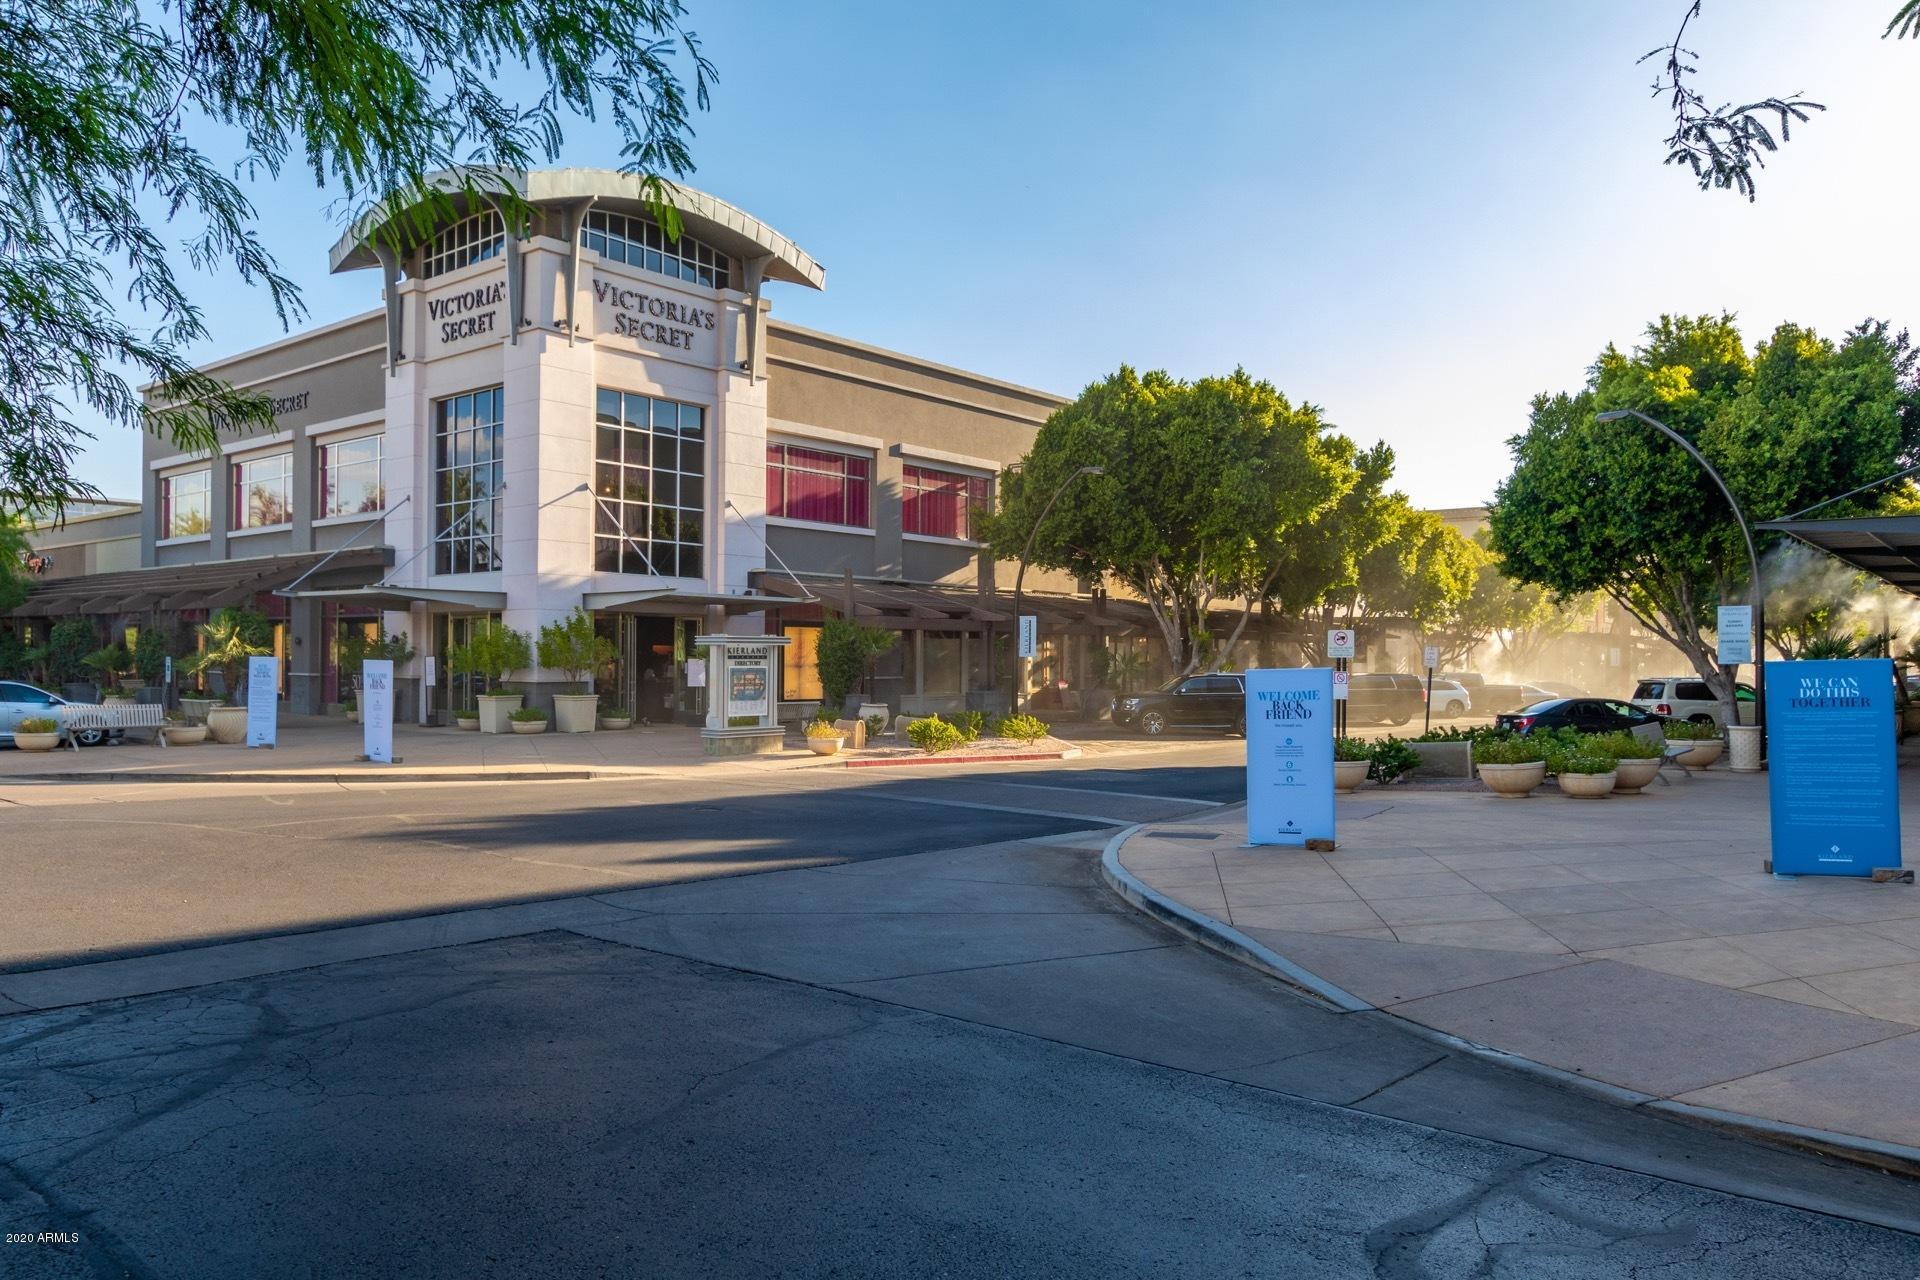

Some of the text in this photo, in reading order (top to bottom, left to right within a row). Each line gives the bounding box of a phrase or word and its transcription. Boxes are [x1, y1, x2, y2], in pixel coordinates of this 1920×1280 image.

[427, 280, 506, 321] VICTORIA'
[592, 278, 716, 331] VICTORIA'S
[441, 310, 496, 343] SECRET
[614, 312, 694, 350] SECRET
[727, 646, 768, 655] KIERLAND
[1800, 677, 1858, 688] WE CAN
[1257, 690, 1321, 702] WELCOME
[1800, 687, 1860, 698] DO THIS
[1272, 700, 1305, 711] BACK
[1791, 697, 1871, 709] TOGETHER
[1265, 709, 1312, 720] FRIEND
